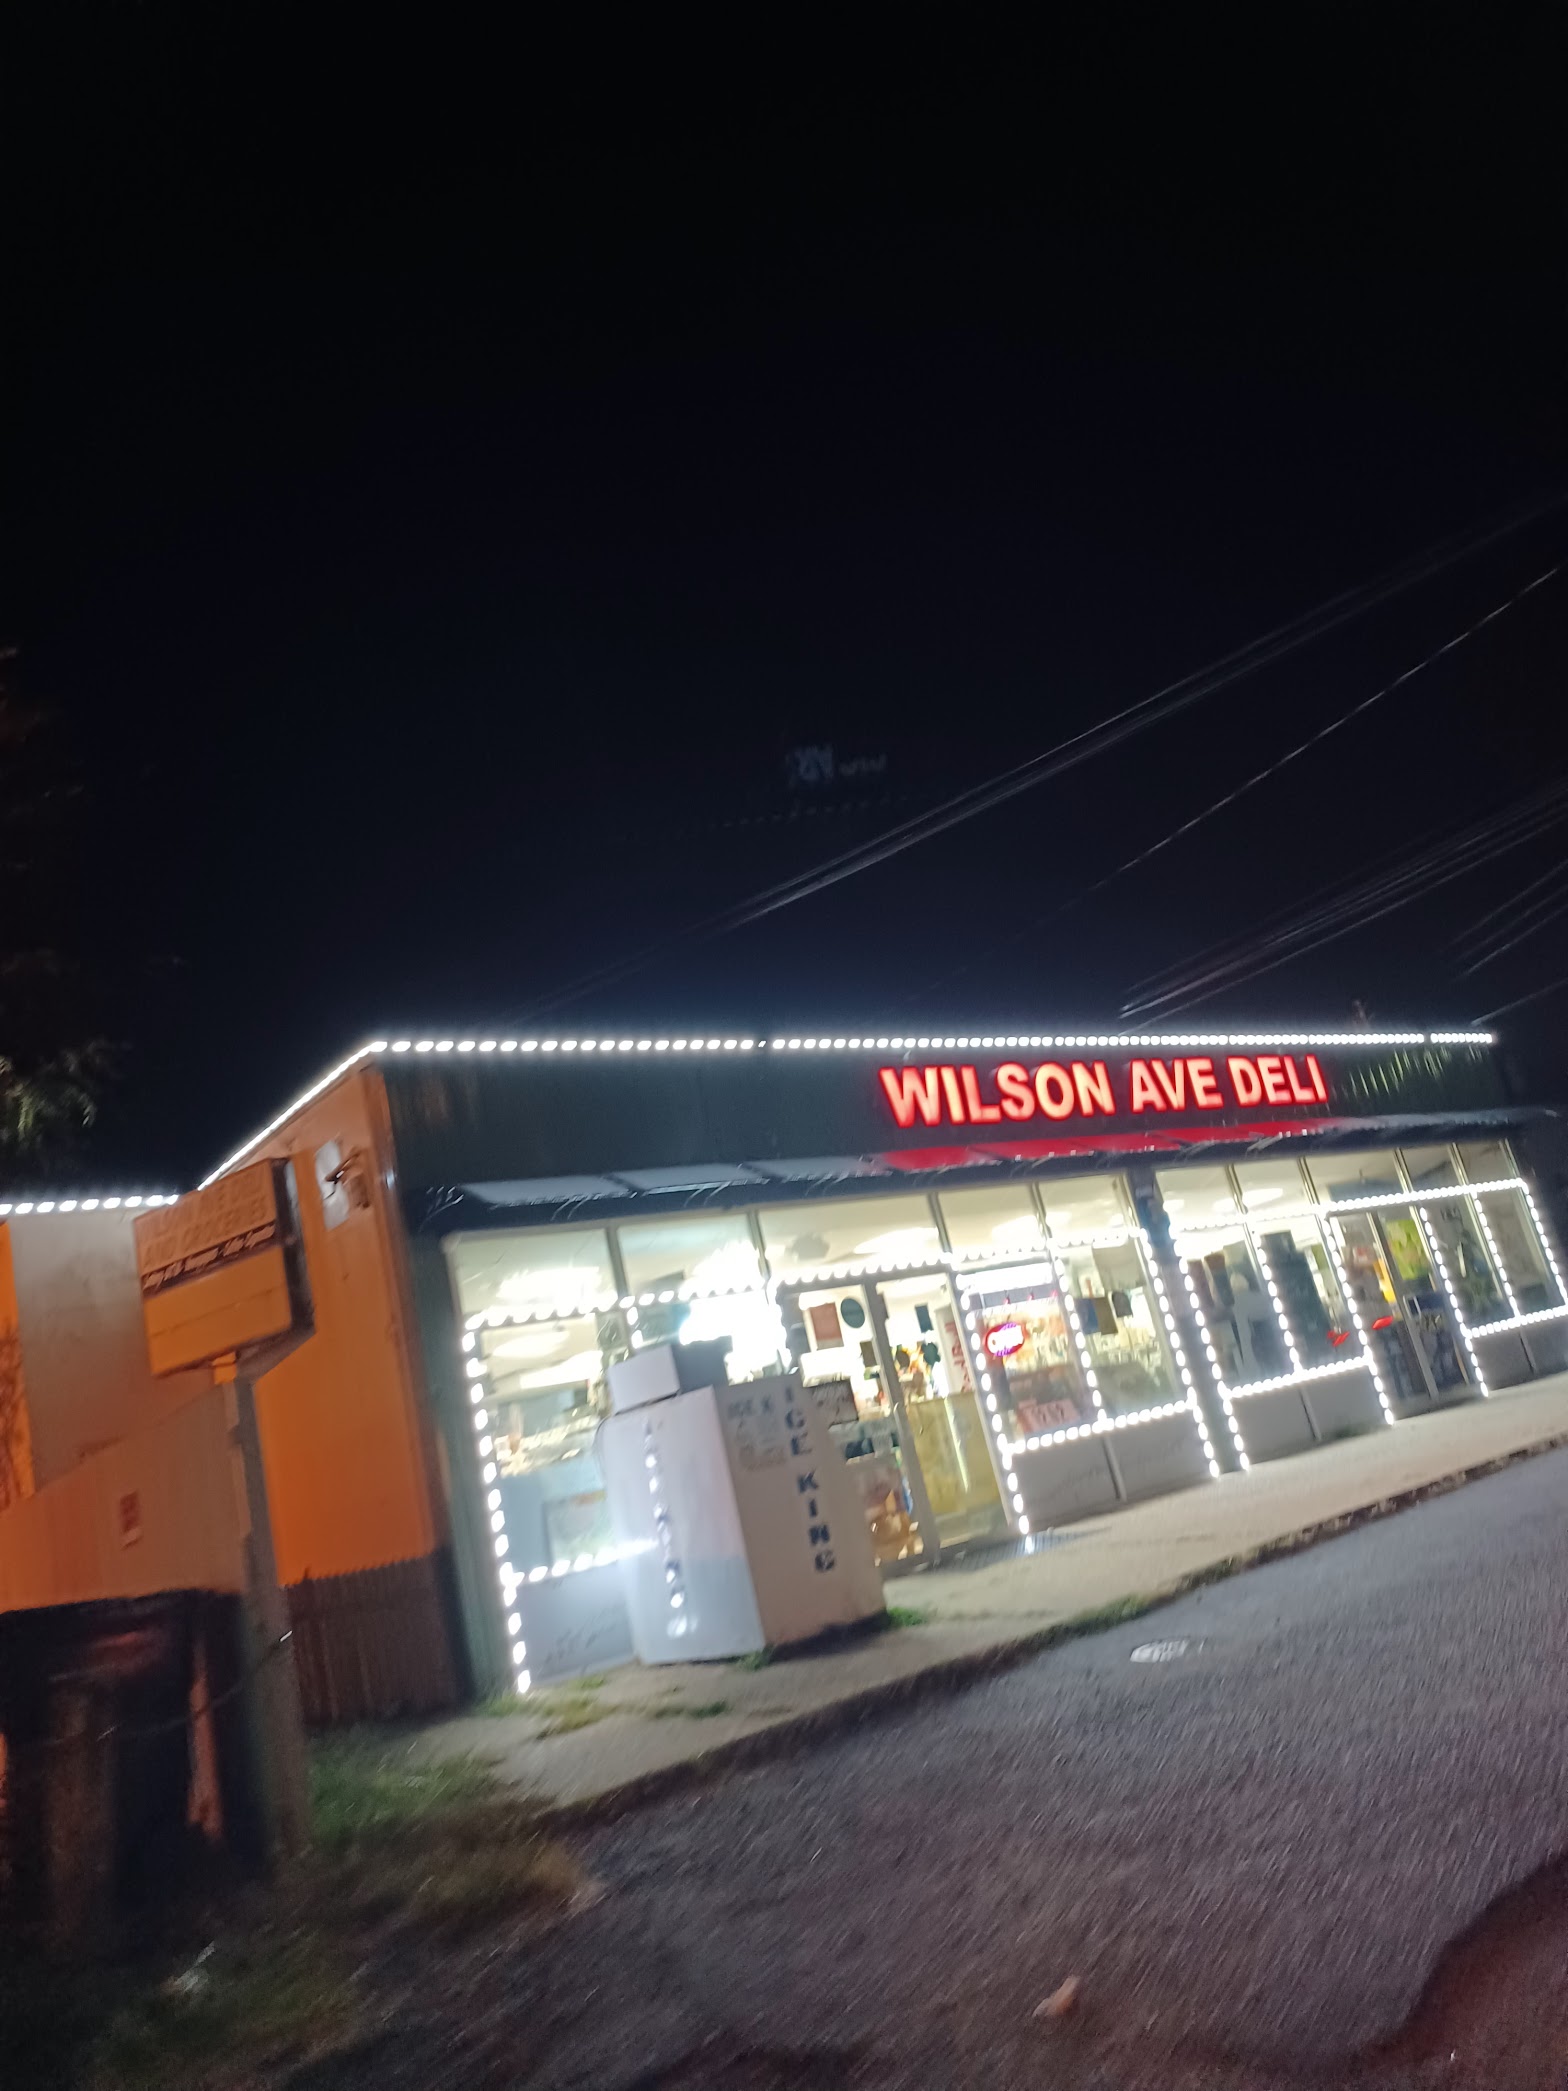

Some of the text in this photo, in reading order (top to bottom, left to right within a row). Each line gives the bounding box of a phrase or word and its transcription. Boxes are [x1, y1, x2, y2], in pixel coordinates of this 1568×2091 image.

[879, 1053, 1329, 1128] WILSON AVE DELI
[784, 1386, 813, 1456] ICE
[796, 1468, 836, 1572] KING
